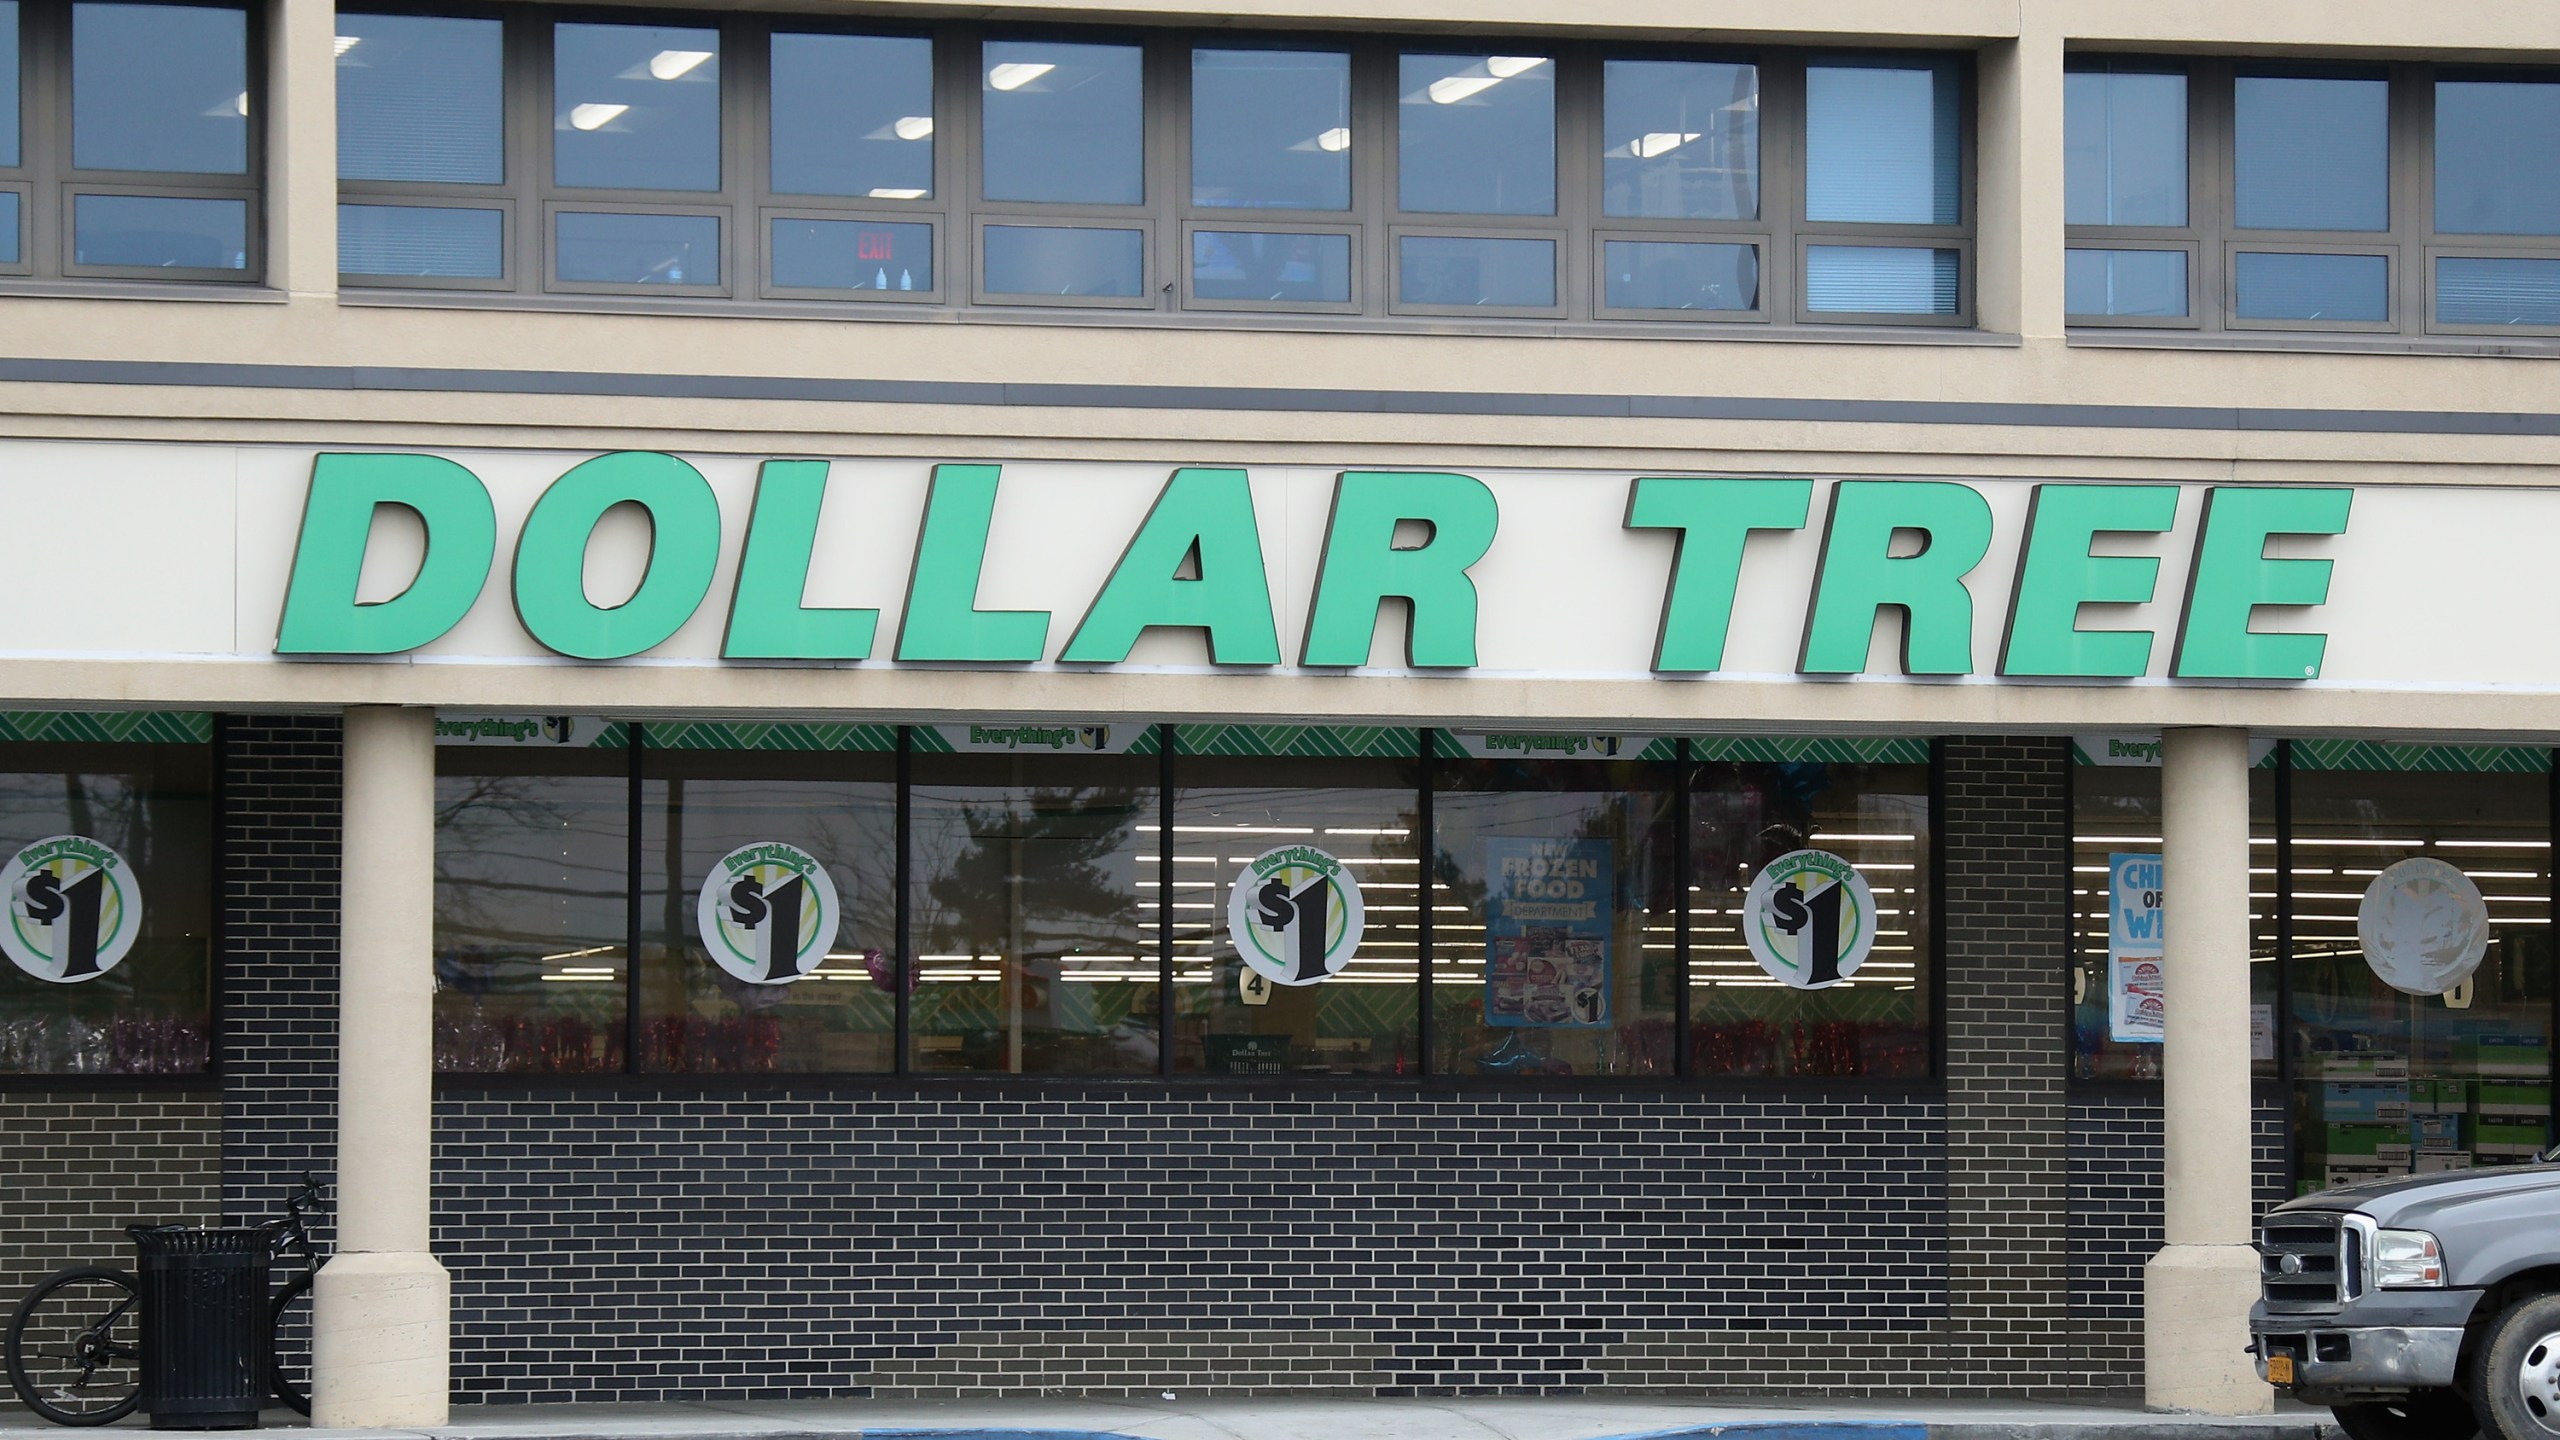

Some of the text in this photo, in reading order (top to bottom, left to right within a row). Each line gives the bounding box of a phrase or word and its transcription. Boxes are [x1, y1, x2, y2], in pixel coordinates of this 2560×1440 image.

[858, 232, 894, 259] EXIT
[272, 450, 2355, 680] DOLLAR TREE
[970, 726, 1075, 749] Everything's
[2109, 739, 2162, 762] Everyt
[18, 838, 118, 869] Everything's
[723, 844, 817, 875] Everything's
[1250, 846, 1341, 876] Everything's
[1502, 858, 1598, 878] FROZEN
[1766, 851, 1855, 881] Everything's
[1514, 879, 1585, 898] FOOD
[20, 868, 103, 978] $1
[725, 872, 803, 981] $1
[1514, 905, 1584, 918] DEPARTMENT
[1254, 874, 1331, 981] $1
[1768, 880, 1844, 985] $1
[1247, 973, 1264, 996] 4
